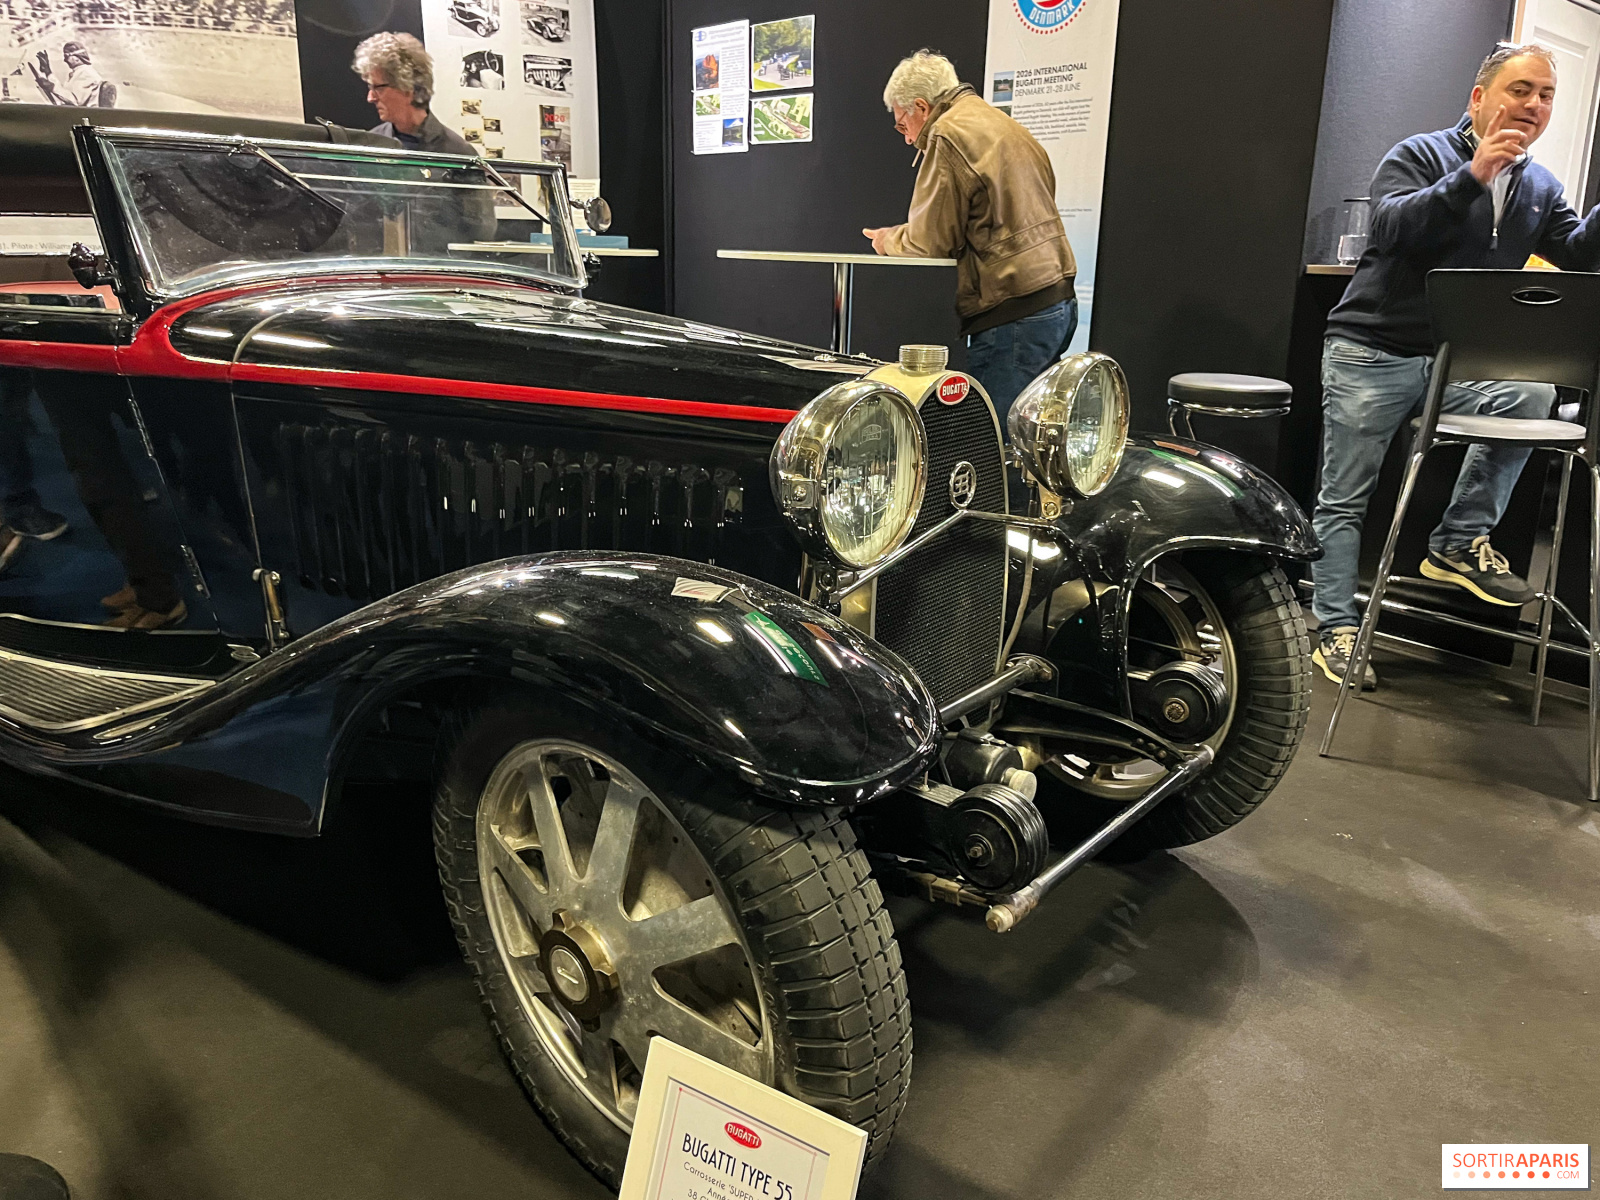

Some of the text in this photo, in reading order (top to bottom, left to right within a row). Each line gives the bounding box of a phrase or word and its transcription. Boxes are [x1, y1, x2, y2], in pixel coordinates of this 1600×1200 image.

[1029, 0, 1075, 25] DENMARK
[1016, 62, 1088, 78] 2026 INTERNATIONAL
[1015, 73, 1074, 88] BUGATTI MEETING
[1014, 87, 1045, 97] DENMARK
[1064, 82, 1081, 92] JUNE
[544, 112, 566, 123] 2020
[727, 1123, 760, 1146] BUGATTI
[682, 1132, 793, 1200] BUGATTI TYPE 55
[683, 1161, 726, 1191] Carrosserie
[687, 1188, 698, 1200] 38
